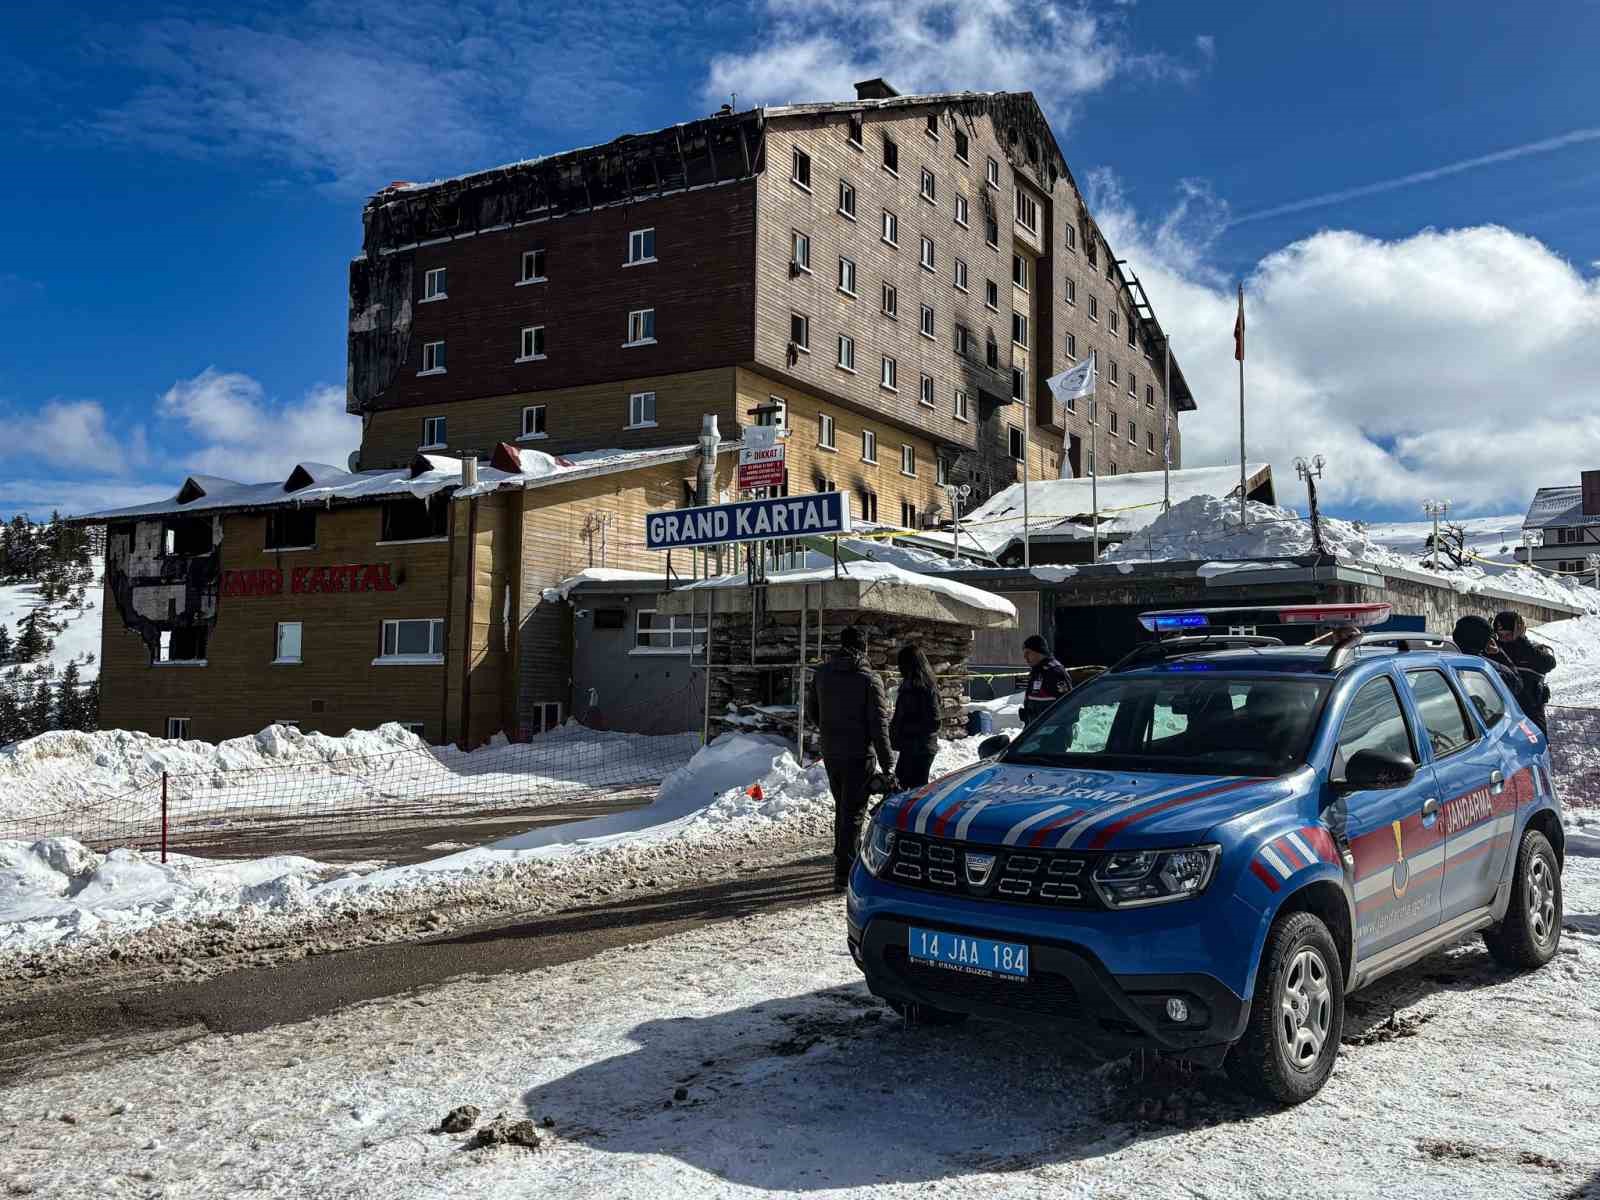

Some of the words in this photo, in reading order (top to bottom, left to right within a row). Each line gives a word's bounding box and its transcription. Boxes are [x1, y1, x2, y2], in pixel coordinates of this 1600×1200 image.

[650, 510, 729, 543] GRAND
[736, 499, 838, 535] KARTAL
[290, 563, 397, 593] KARTAL
[964, 783, 1137, 802] JANDARMA
[1447, 788, 1493, 833] JANDARMA
[921, 932, 939, 957] 14
[948, 938, 979, 964] JAA
[993, 945, 1024, 973] 184
